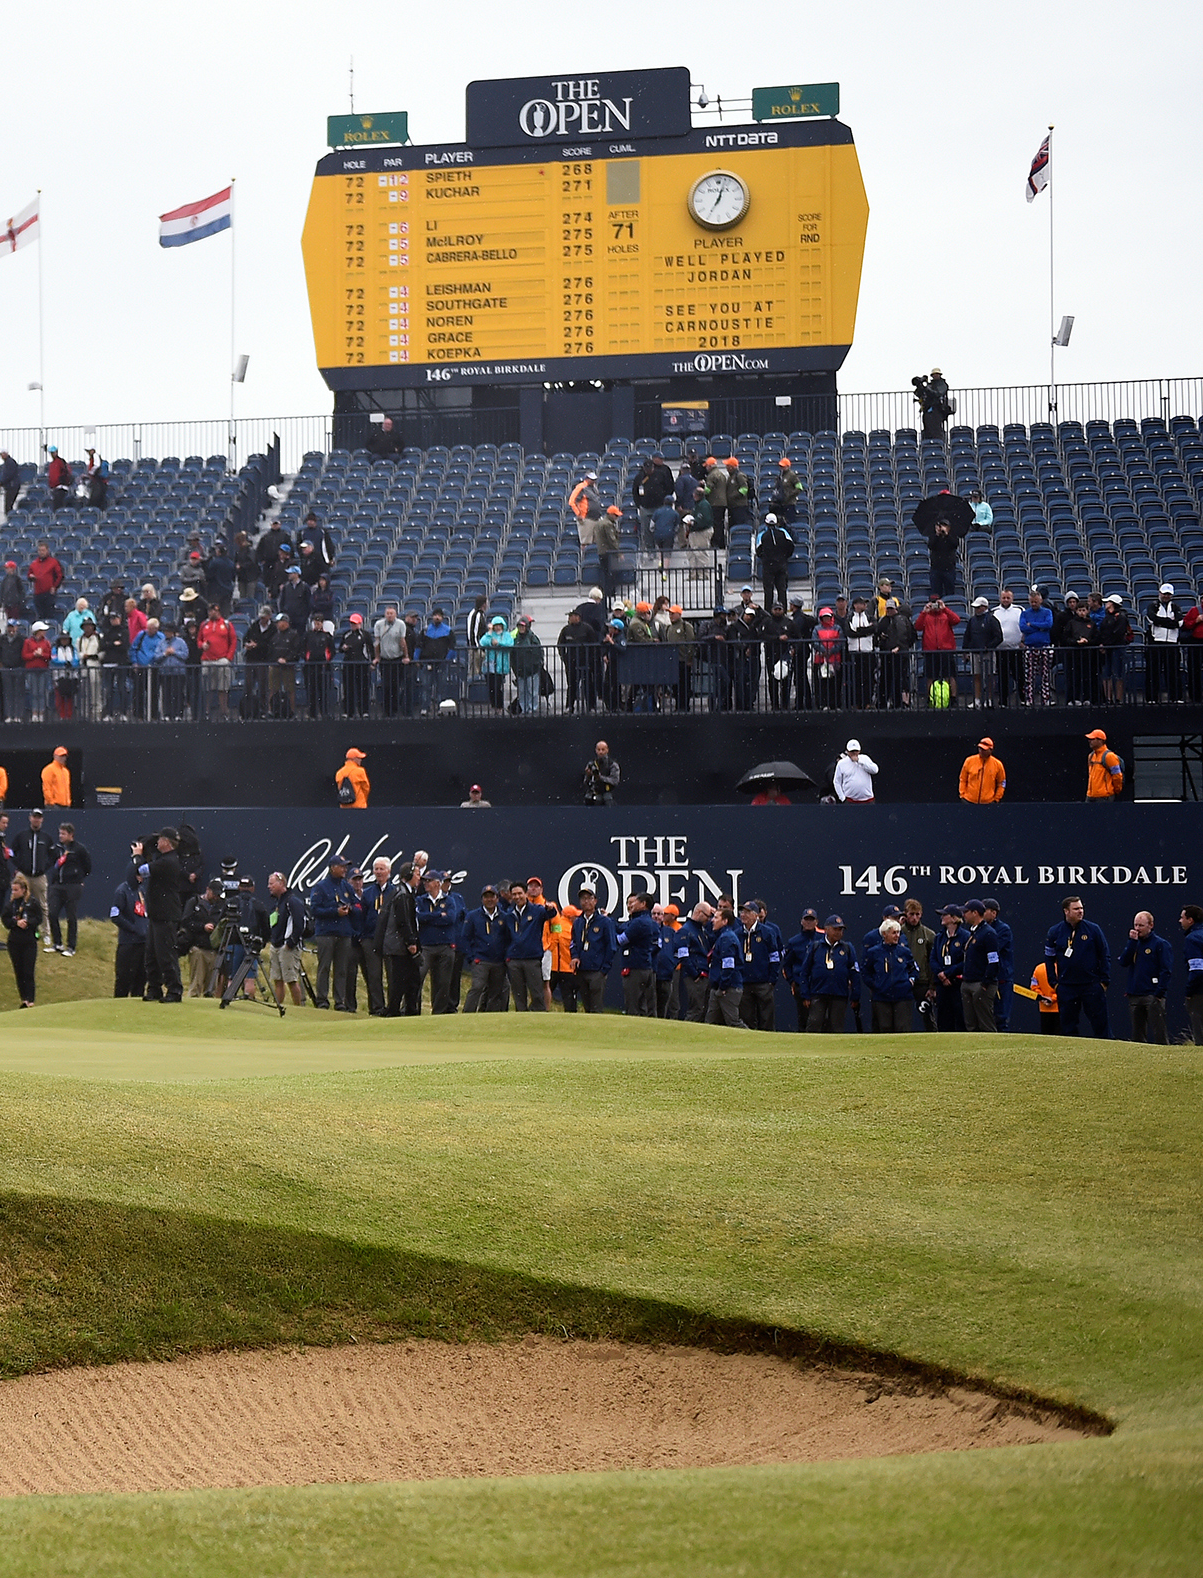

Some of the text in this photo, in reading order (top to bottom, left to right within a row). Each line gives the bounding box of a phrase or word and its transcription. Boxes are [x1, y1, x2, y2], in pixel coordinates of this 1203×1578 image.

[551, 80, 601, 101] THE
[518, 98, 634, 138] OPEN
[771, 103, 821, 116] ROLEX
[343, 131, 390, 142] ROLEX
[343, 160, 366, 169] HOLE
[383, 158, 403, 167] PAR
[425, 151, 474, 164] PLAYER
[562, 147, 592, 157] SCORE
[345, 177, 364, 188] 72
[426, 171, 472, 183] SPIETH
[563, 164, 593, 176] 268
[345, 193, 364, 204] 72
[426, 186, 480, 199] KUCHAR
[563, 180, 593, 192] 271
[345, 225, 364, 236] 72
[426, 221, 438, 231] LI
[563, 212, 593, 224] 274
[607, 210, 639, 220] AFTER
[797, 213, 822, 222] SCORE
[612, 223, 634, 239] 71
[802, 223, 818, 231] FOR
[345, 241, 364, 252] 72
[426, 235, 484, 248] McILROY
[563, 228, 593, 241] 275
[694, 237, 743, 249] PLAYER
[800, 234, 820, 243] RND
[345, 257, 364, 268] 72
[427, 249, 517, 264] CABRERA-BELLO
[563, 245, 593, 257] 275
[607, 244, 639, 254] HOLES
[665, 251, 785, 267] WELL PLAYED
[687, 269, 752, 283] JORDAN
[345, 288, 364, 300] 72
[426, 283, 492, 296] LEISHMAN
[563, 277, 593, 289] 276
[345, 304, 364, 316] 72
[426, 298, 508, 311] SOUTHGATE
[563, 294, 593, 305] 276
[665, 301, 774, 316] SEE YOU AT
[345, 321, 364, 332] 72
[426, 315, 473, 328] NOREN
[563, 310, 593, 322] 276
[665, 317, 774, 333] CARNOUSTIE
[345, 336, 364, 348] 72
[427, 332, 473, 344] GRACE
[563, 326, 593, 338] 276
[699, 335, 740, 348] 2018
[345, 352, 364, 364] 72
[427, 348, 481, 360] KOEPKA
[563, 343, 593, 354] 276
[460, 365, 492, 376] ROYAL
[494, 364, 546, 374] BIRKDALE
[609, 836, 690, 867] THE
[939, 866, 1029, 884] ROYAL
[1037, 866, 1188, 884] BIRKDALE
[557, 862, 744, 922] OPEN
